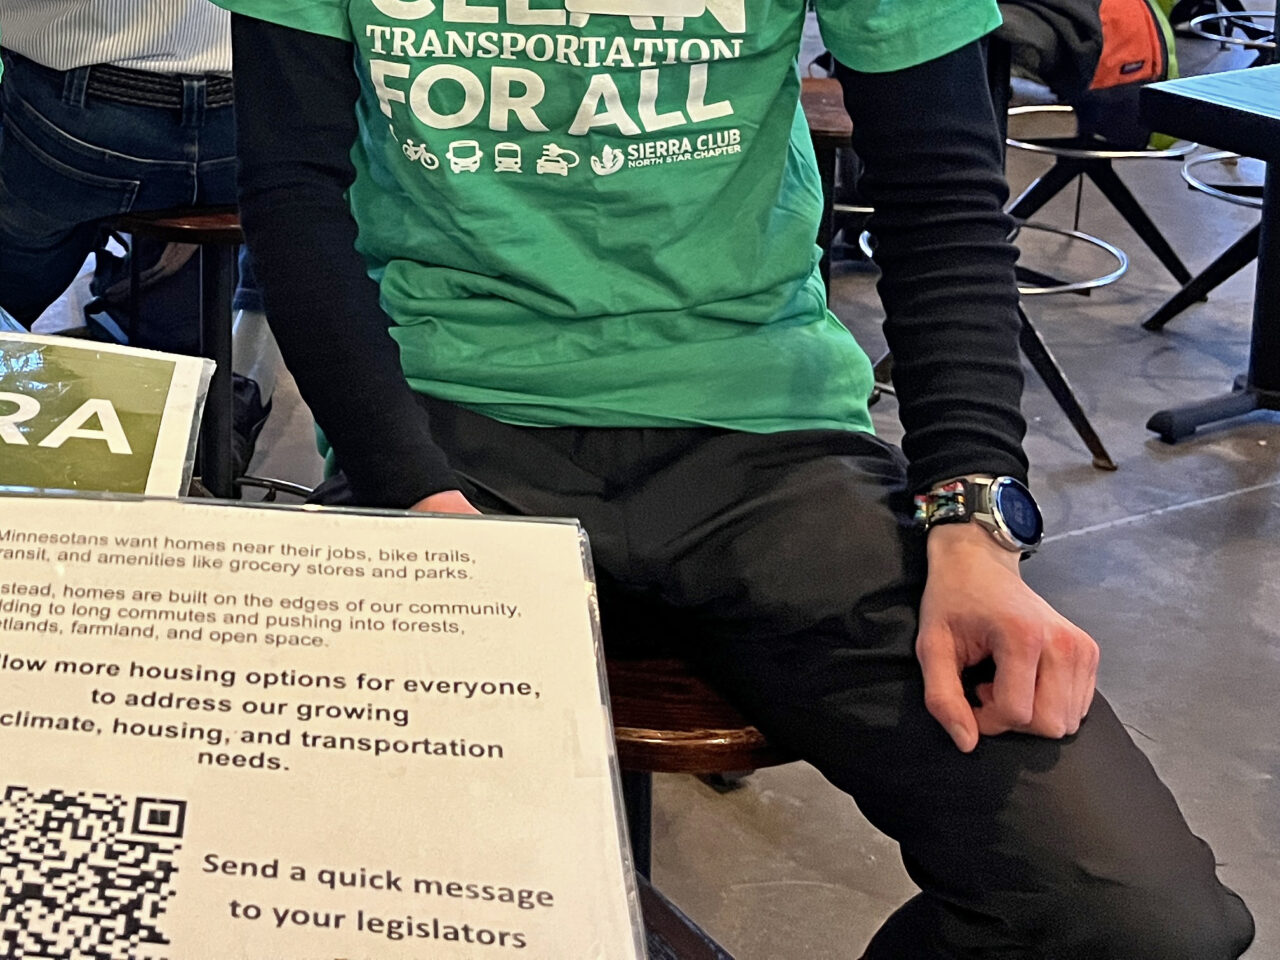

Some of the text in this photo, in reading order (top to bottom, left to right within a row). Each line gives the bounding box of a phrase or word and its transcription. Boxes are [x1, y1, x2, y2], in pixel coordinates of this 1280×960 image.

[366, 24, 744, 69] TRANSPORTATION
[369, 59, 735, 137] FOR ALL
[627, 128, 742, 160] SIERRA CLUB
[627, 145, 742, 168] NORTH STAR CHAPTER
[57, 549, 92, 563] and
[97, 553, 186, 568] amenities
[192, 555, 223, 569] like
[229, 559, 301, 577] grocery
[307, 563, 365, 577] stores
[371, 565, 407, 579] and
[114, 536, 158, 549] want
[164, 536, 226, 552] homes
[232, 542, 275, 555] near
[280, 543, 322, 558] their
[379, 548, 418, 562] bike
[63, 583, 125, 601] homes
[131, 590, 163, 603] are
[168, 589, 208, 605] built
[213, 594, 237, 606] on
[243, 593, 273, 608] the
[279, 596, 340, 613] edges
[345, 598, 365, 612] of
[370, 602, 403, 614] our
[48, 601, 66, 616] to
[71, 602, 111, 621] long
[117, 607, 217, 623] commutes
[223, 611, 259, 626] and
[265, 614, 342, 633] pushing
[349, 616, 385, 631] into
[166, 627, 203, 641] and
[209, 630, 258, 645] open
[53, 660, 121, 677] more
[129, 660, 237, 689] housing
[245, 669, 347, 690] options
[355, 672, 395, 692] for
[403, 679, 541, 699] everyone,
[91, 688, 409, 728] to address our growing
[0, 709, 504, 759] climate, housing, and transportation
[197, 751, 290, 771] needs.
[201, 853, 554, 911] Send a quick message
[228, 899, 527, 949] to your legislators
